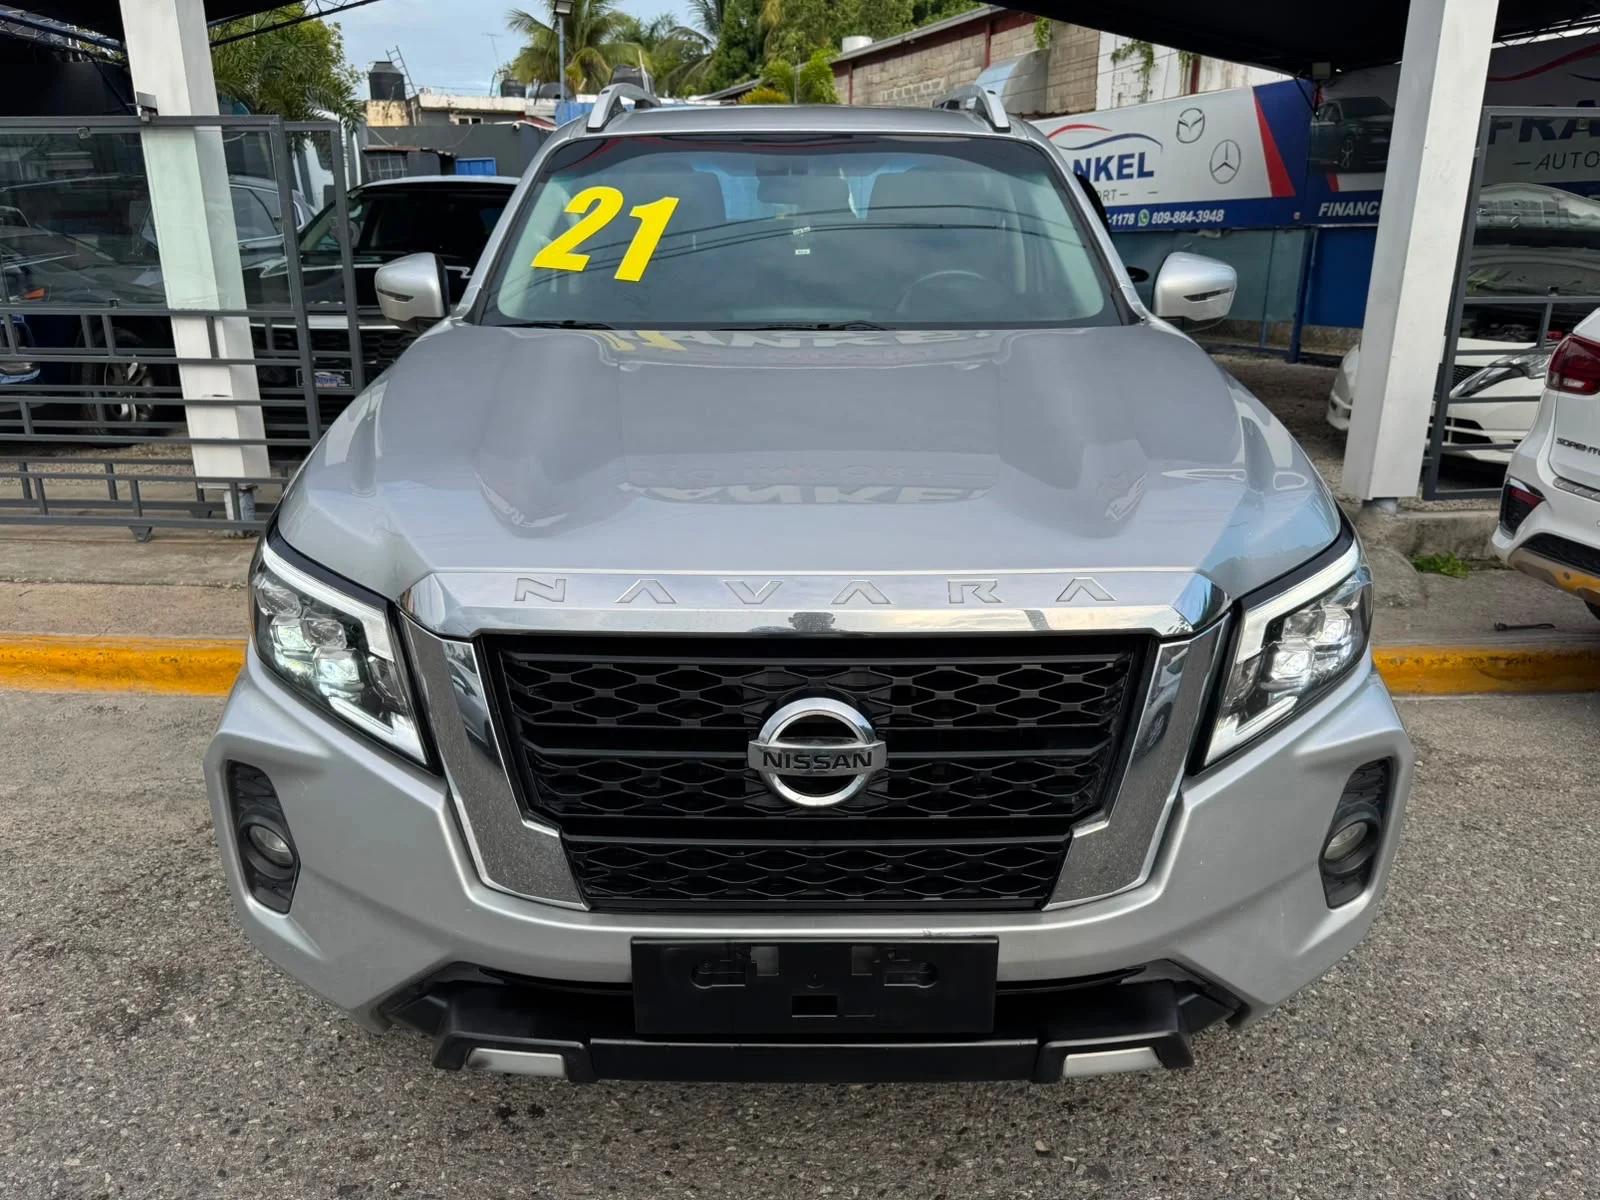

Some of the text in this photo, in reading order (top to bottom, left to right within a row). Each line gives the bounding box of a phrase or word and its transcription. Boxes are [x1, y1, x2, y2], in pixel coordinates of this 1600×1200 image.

[1534, 150, 1600, 171] AUTO
[1152, 209, 1225, 225] 809-884-3948
[1318, 201, 1381, 217] FINANC
[530, 185, 680, 282] 21
[513, 577, 1117, 605] NAVARA
[763, 751, 872, 770] NISSAN
